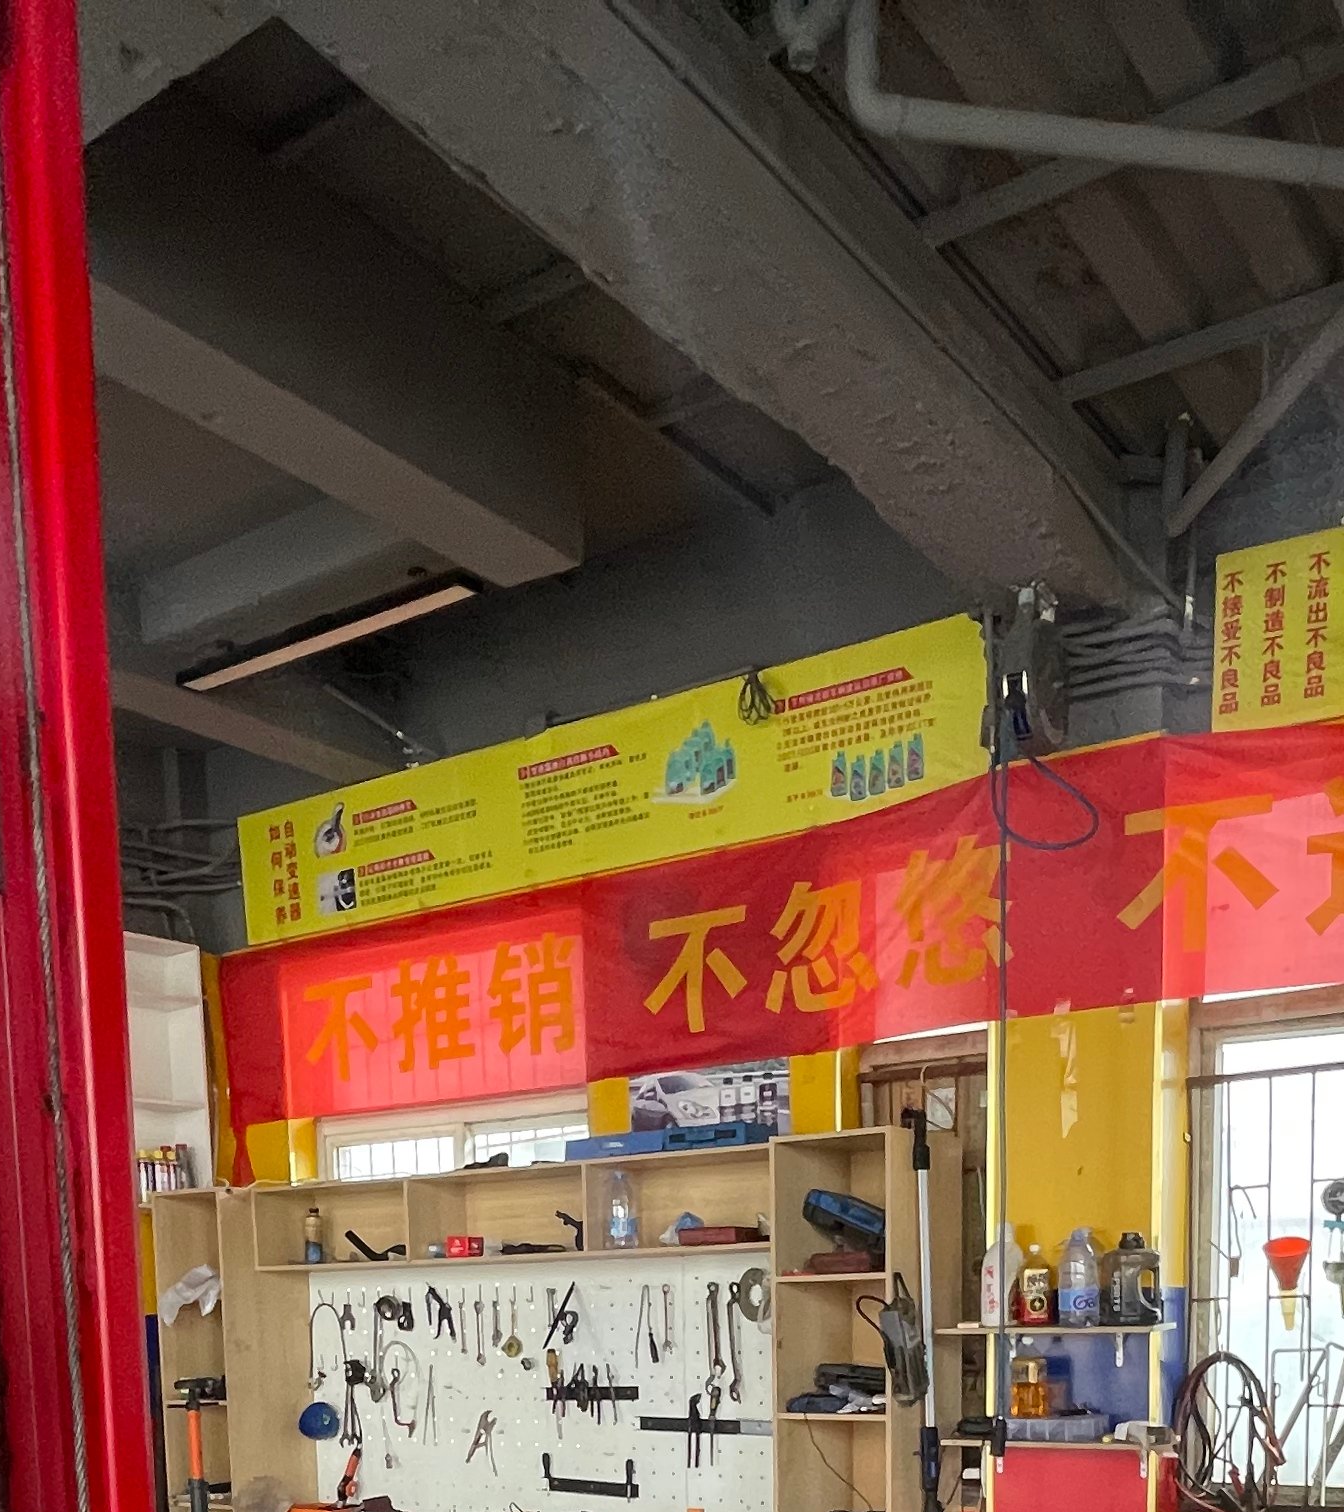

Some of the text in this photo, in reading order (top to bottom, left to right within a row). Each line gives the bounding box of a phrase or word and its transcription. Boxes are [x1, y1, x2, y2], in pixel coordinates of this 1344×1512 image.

[1218, 570, 1244, 716] 不接受不良品
[1261, 561, 1287, 708] 不制造不良品
[1303, 551, 1331, 699] 不流出不良品
[304, 931, 581, 1082] 不推销
[643, 835, 1015, 1033] 不忽悠
